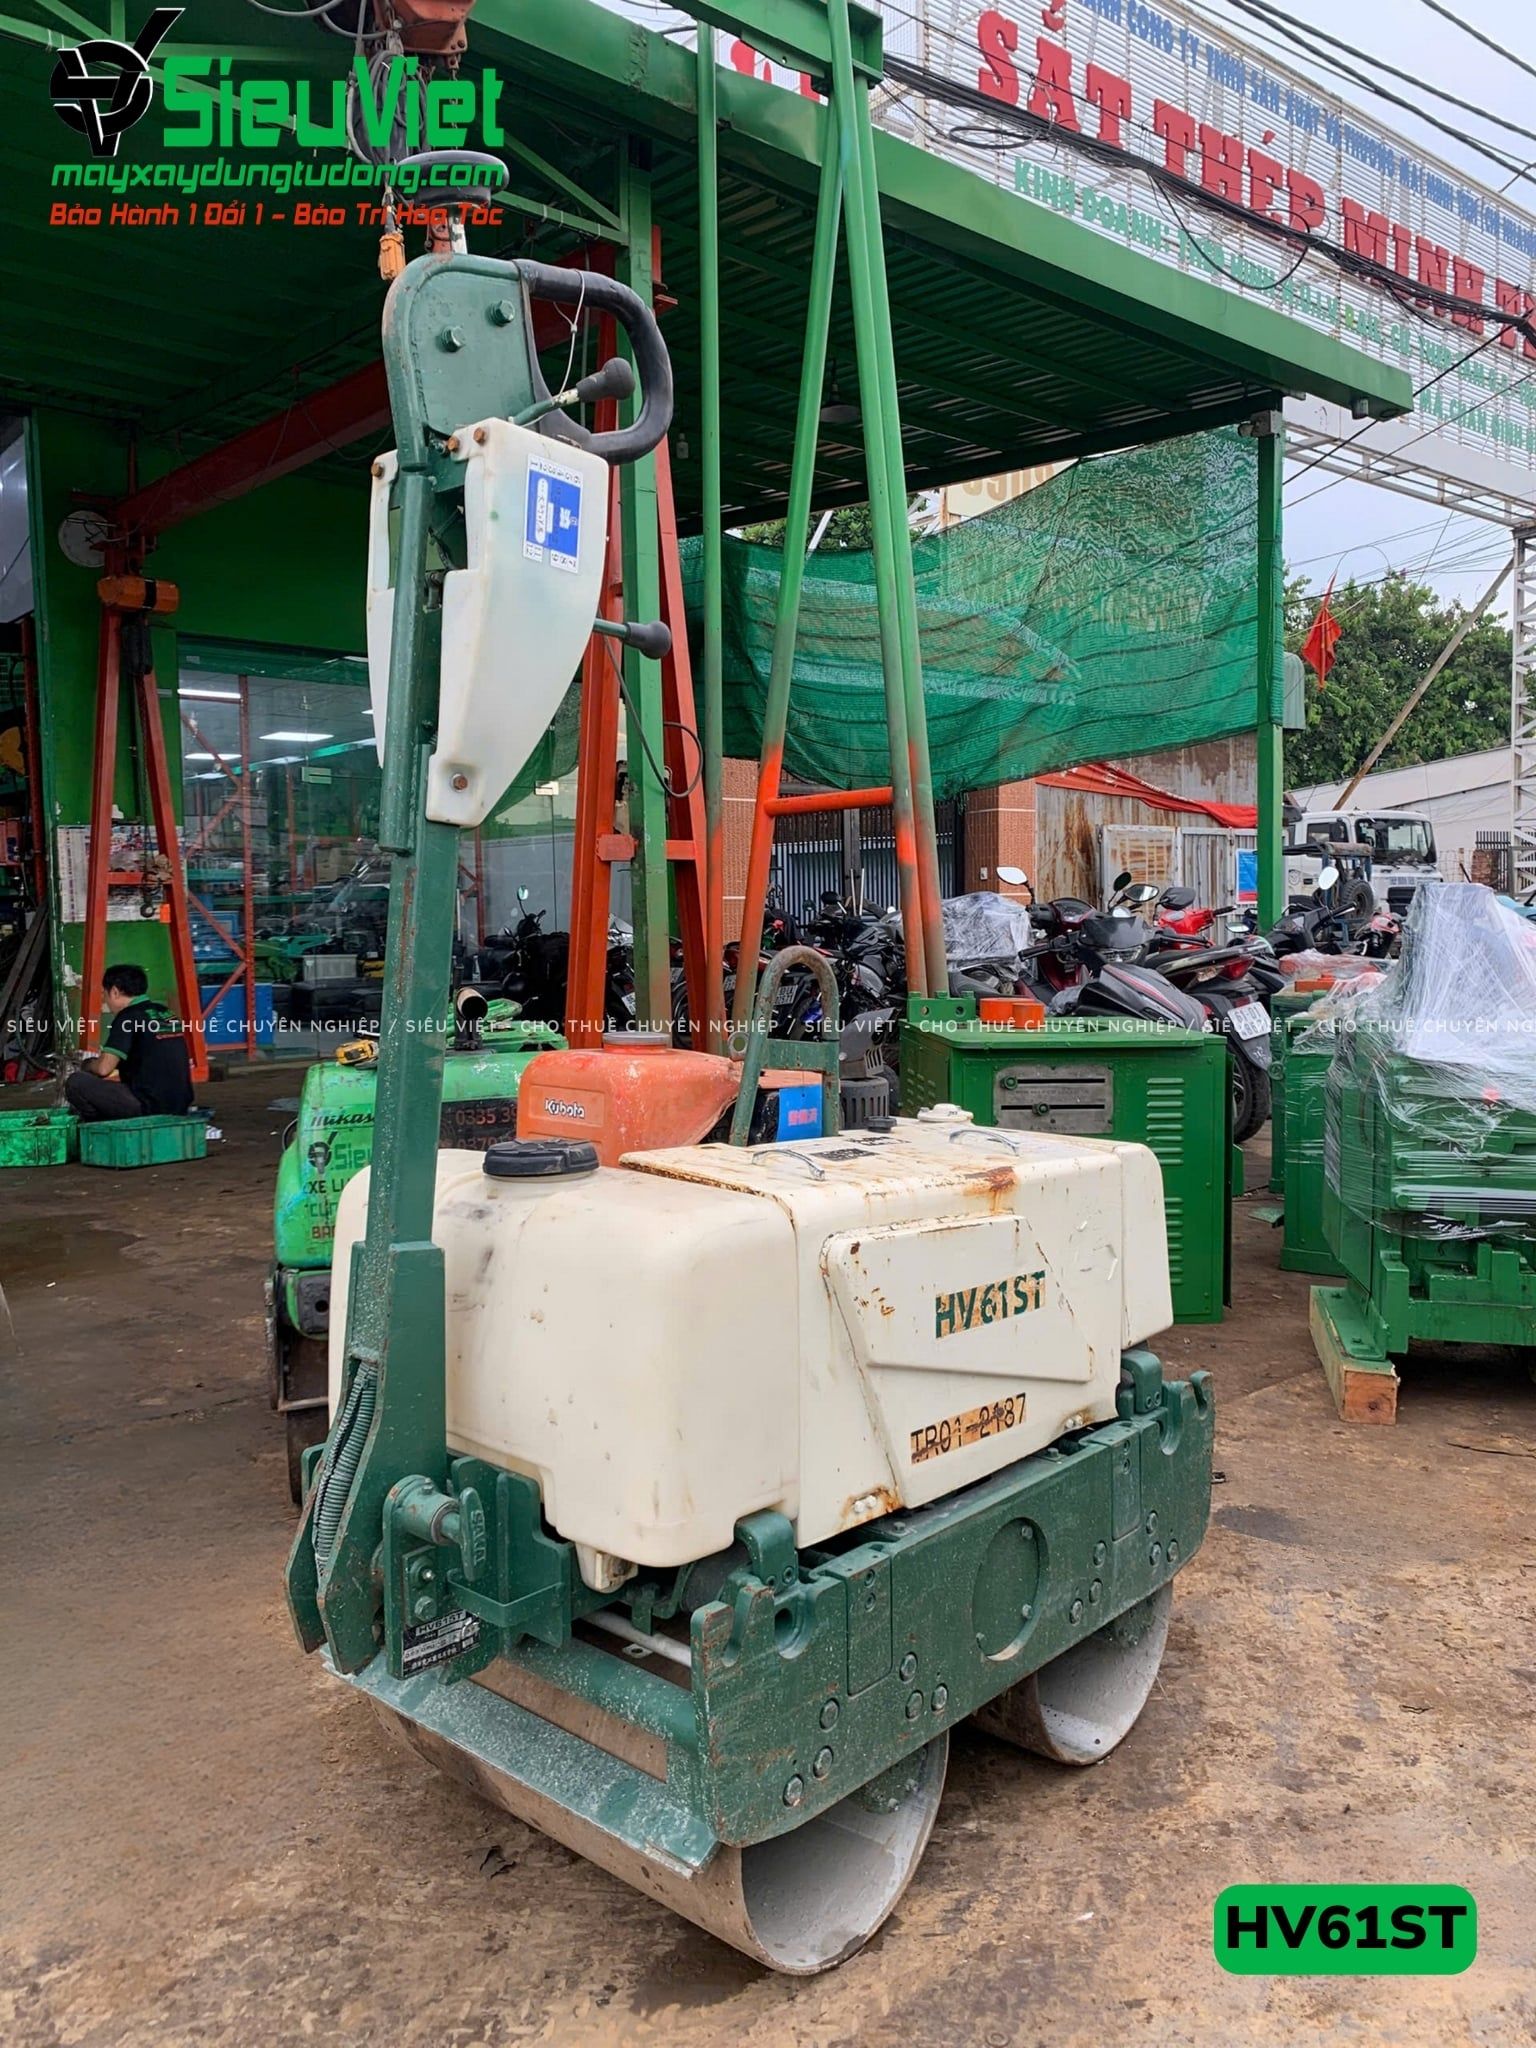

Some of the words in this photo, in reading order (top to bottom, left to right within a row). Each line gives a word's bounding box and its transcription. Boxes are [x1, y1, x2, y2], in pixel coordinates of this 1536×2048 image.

[1015, 157, 1075, 215] KINH
[1154, 99, 1325, 250] THÉP
[1342, 197, 1484, 335] MINH
[545, 1098, 585, 1119] Kubota
[935, 1270, 1047, 1339] HV61ST
